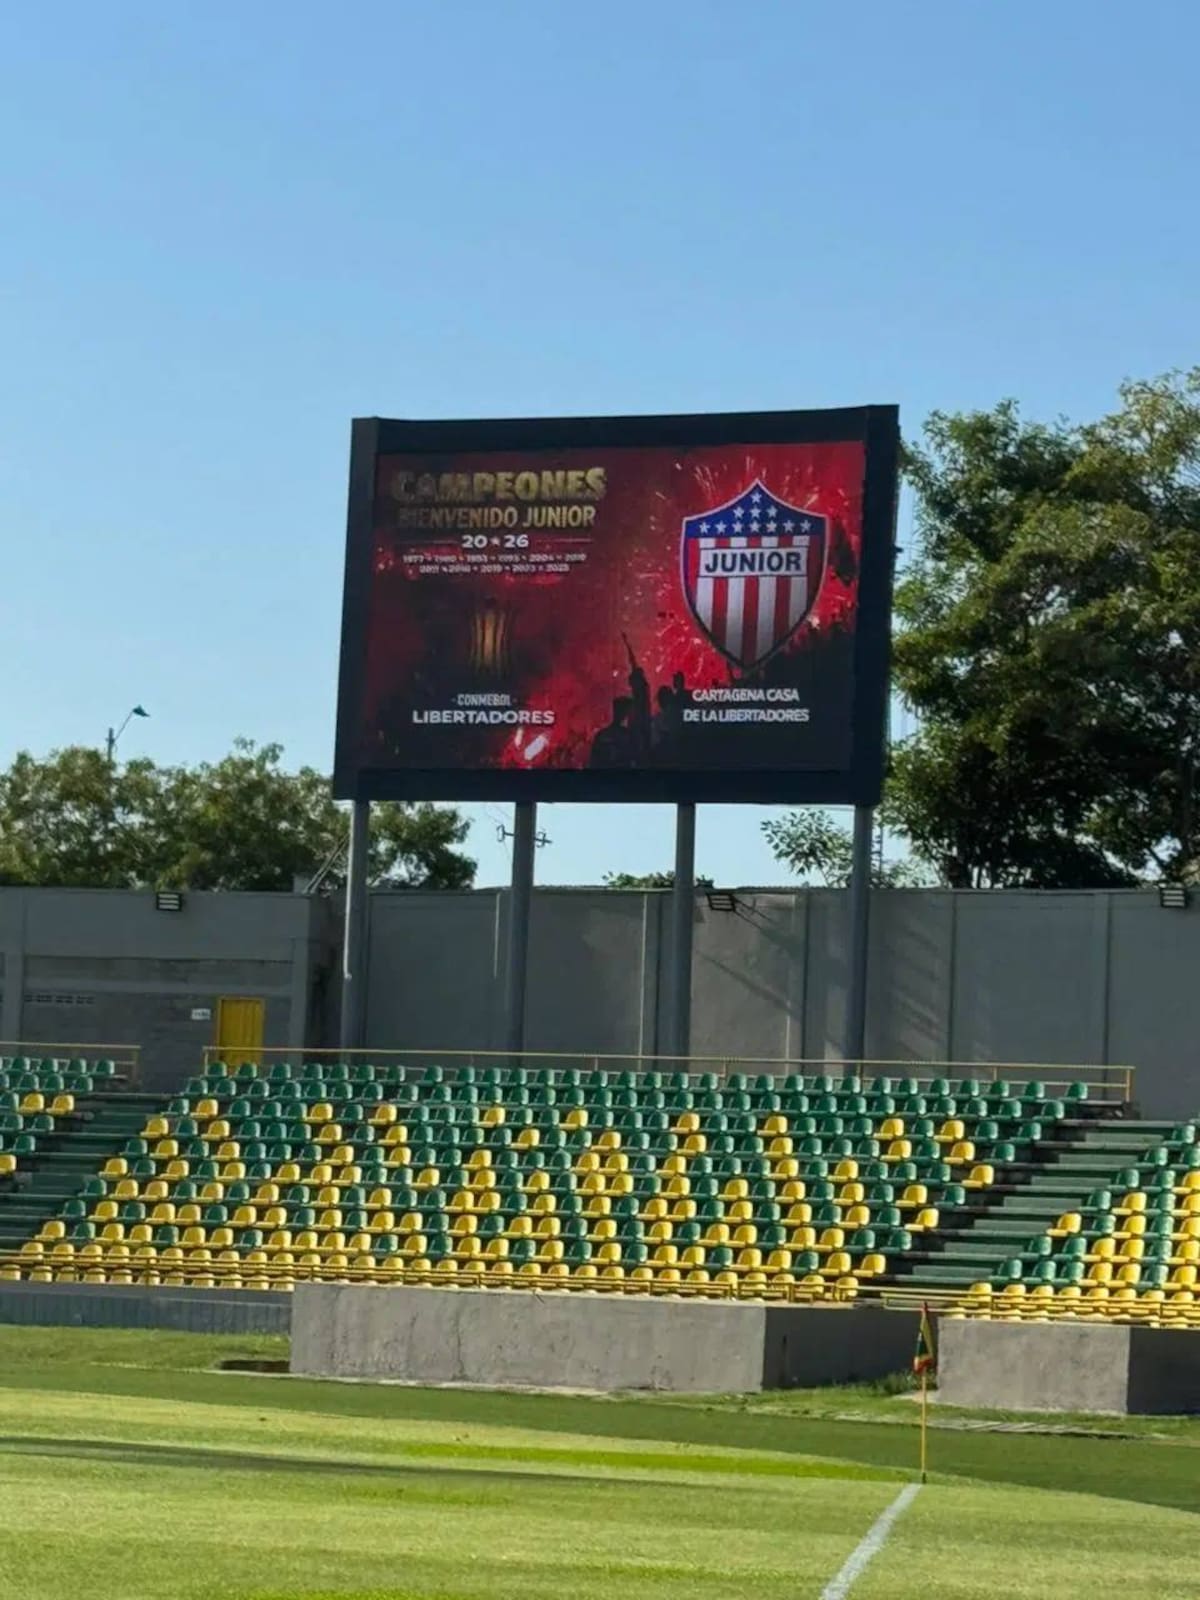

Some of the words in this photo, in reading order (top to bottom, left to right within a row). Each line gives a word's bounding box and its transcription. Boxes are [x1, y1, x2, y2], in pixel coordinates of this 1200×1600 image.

[391, 467, 608, 502] CAMPEONES
[399, 506, 518, 529] BIENVENIDO
[522, 505, 597, 528] JUNIOR
[462, 535, 487, 548] 20
[505, 534, 529, 548] 26
[705, 552, 801, 573] JUNIOR
[457, 694, 512, 706] CONMEBOL
[692, 688, 765, 703] CARTAGENA
[766, 688, 800, 702] CASA
[412, 710, 555, 725] LIBERTADORES
[683, 709, 700, 722] DE
[702, 709, 718, 722] LA
[719, 708, 810, 723] LIBERTADORES
